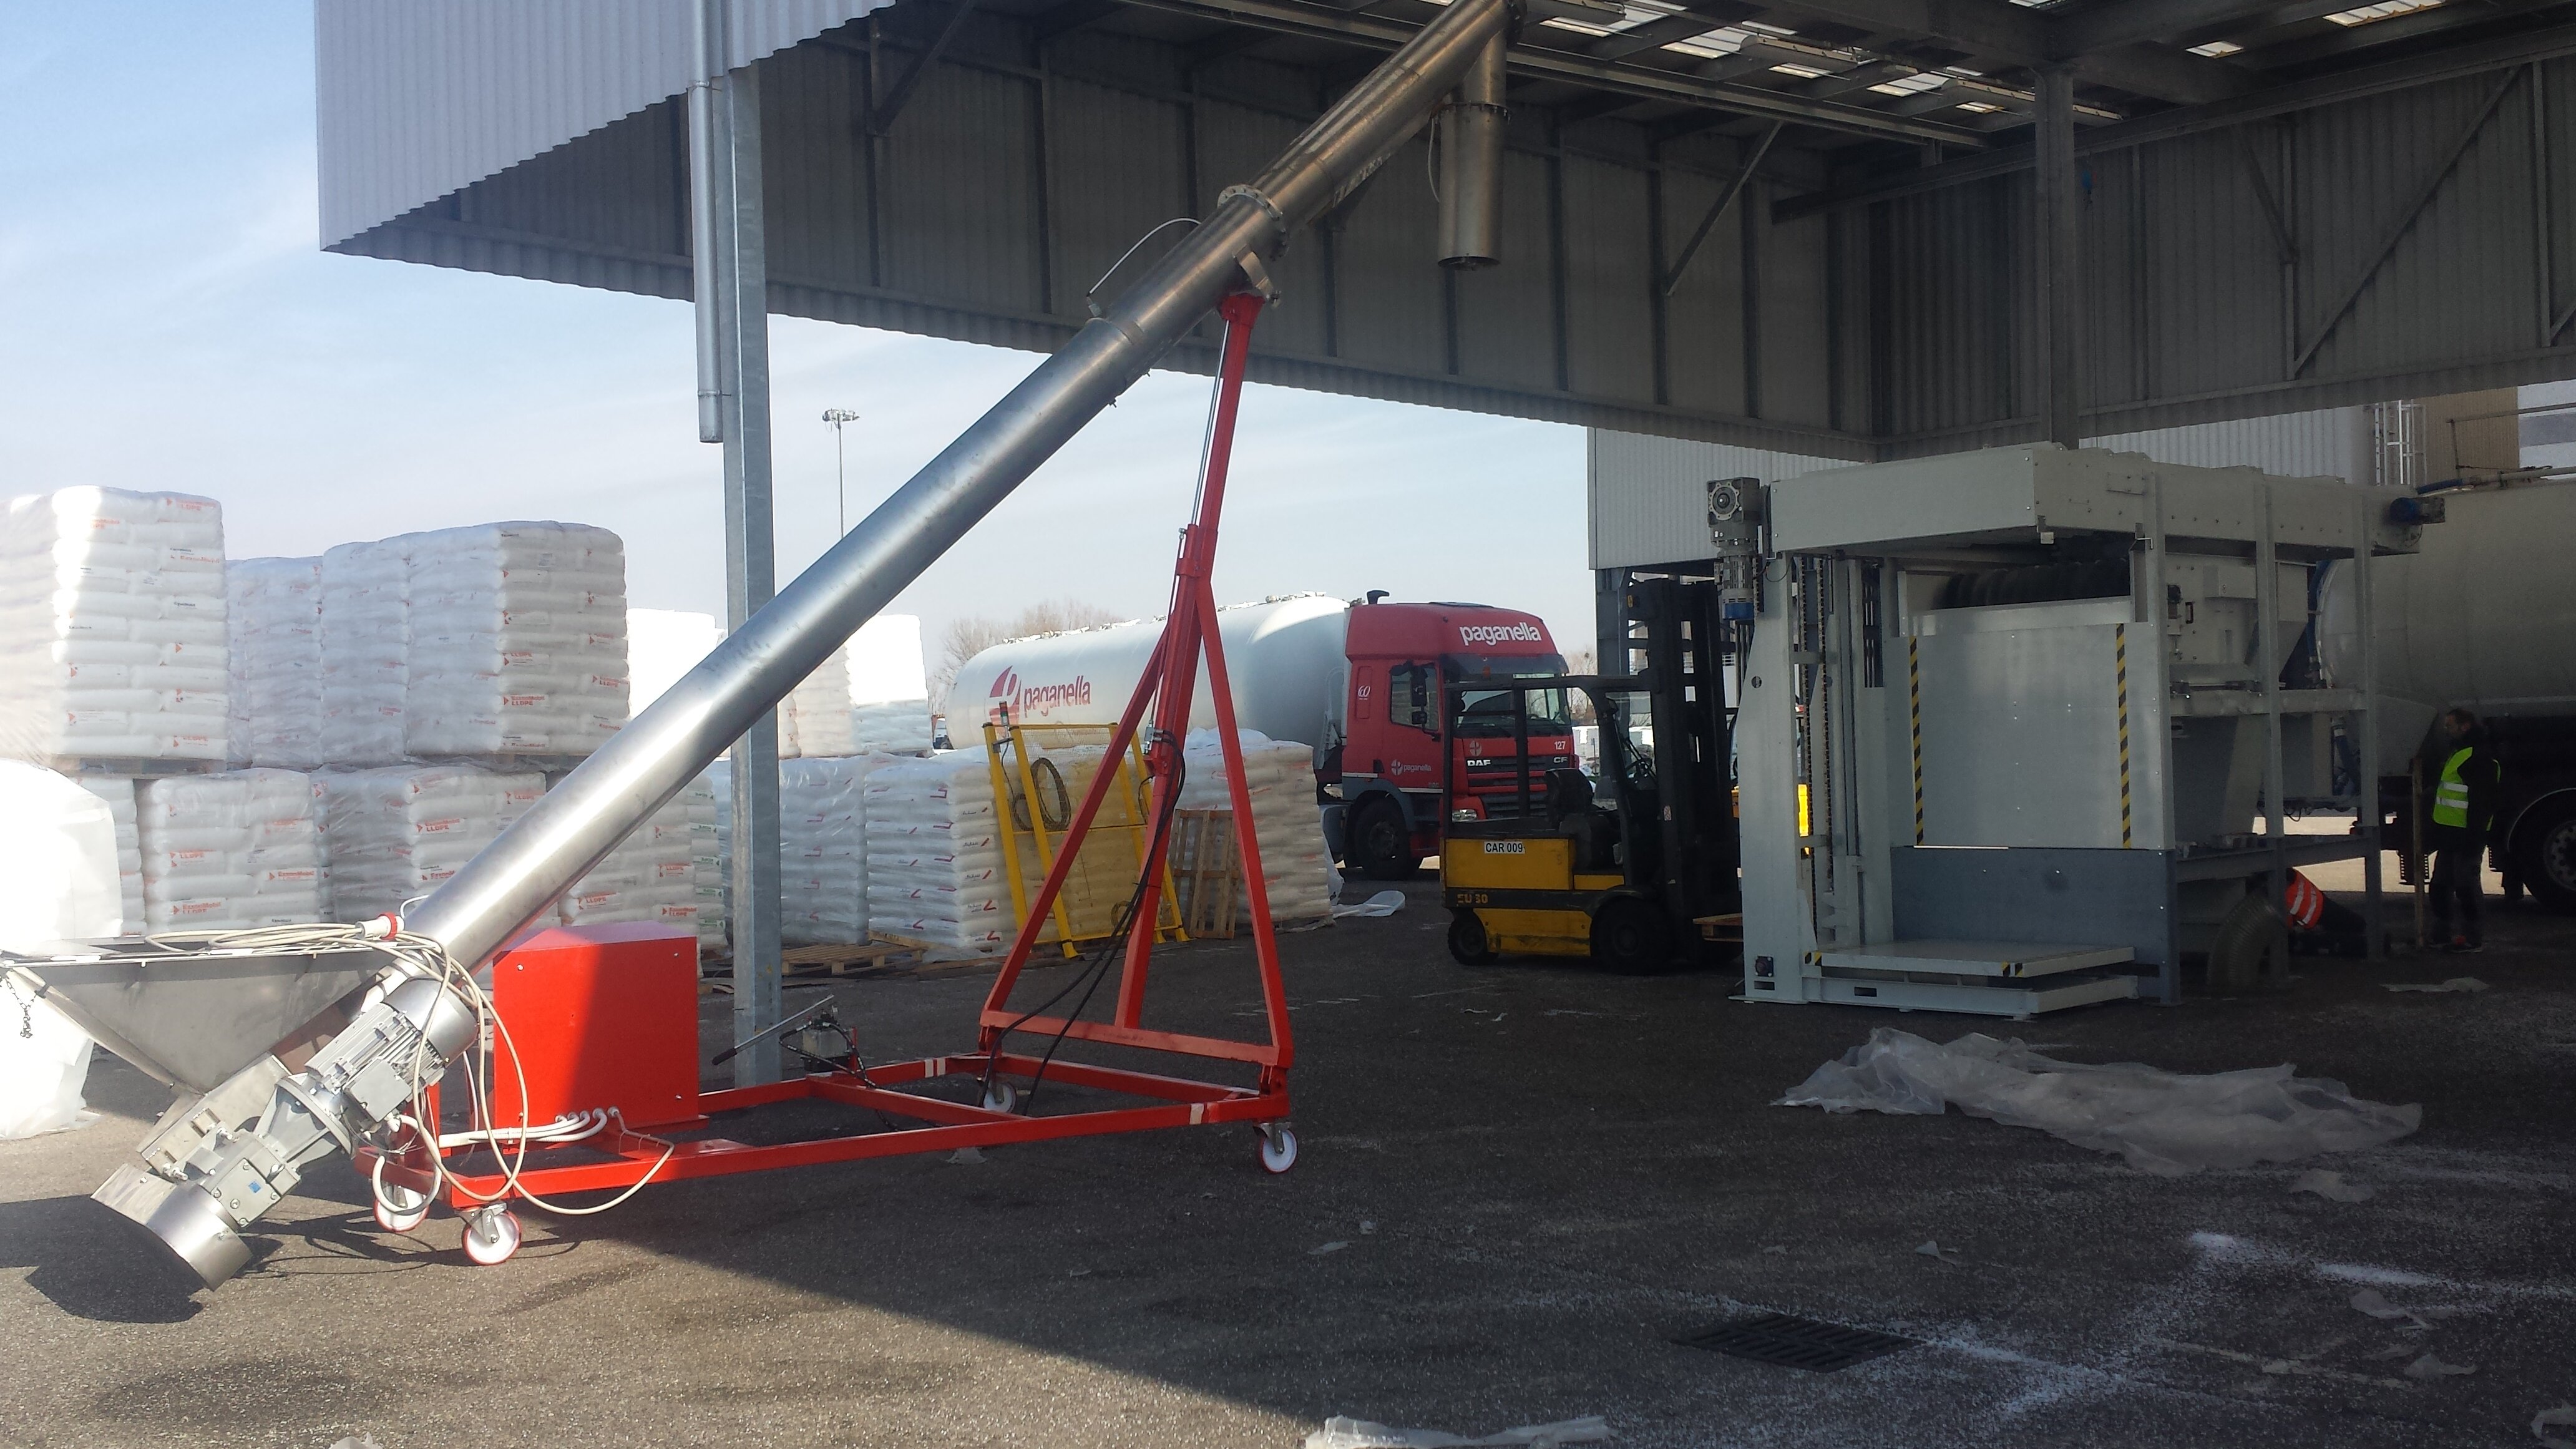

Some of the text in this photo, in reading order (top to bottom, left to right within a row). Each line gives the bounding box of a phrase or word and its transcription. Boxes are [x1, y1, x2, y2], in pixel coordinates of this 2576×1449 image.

[1459, 622, 1542, 646] paganella
[1024, 675, 1091, 718] paganella
[1554, 741, 1566, 750] 127
[1485, 842, 1523, 852] CAR 009
